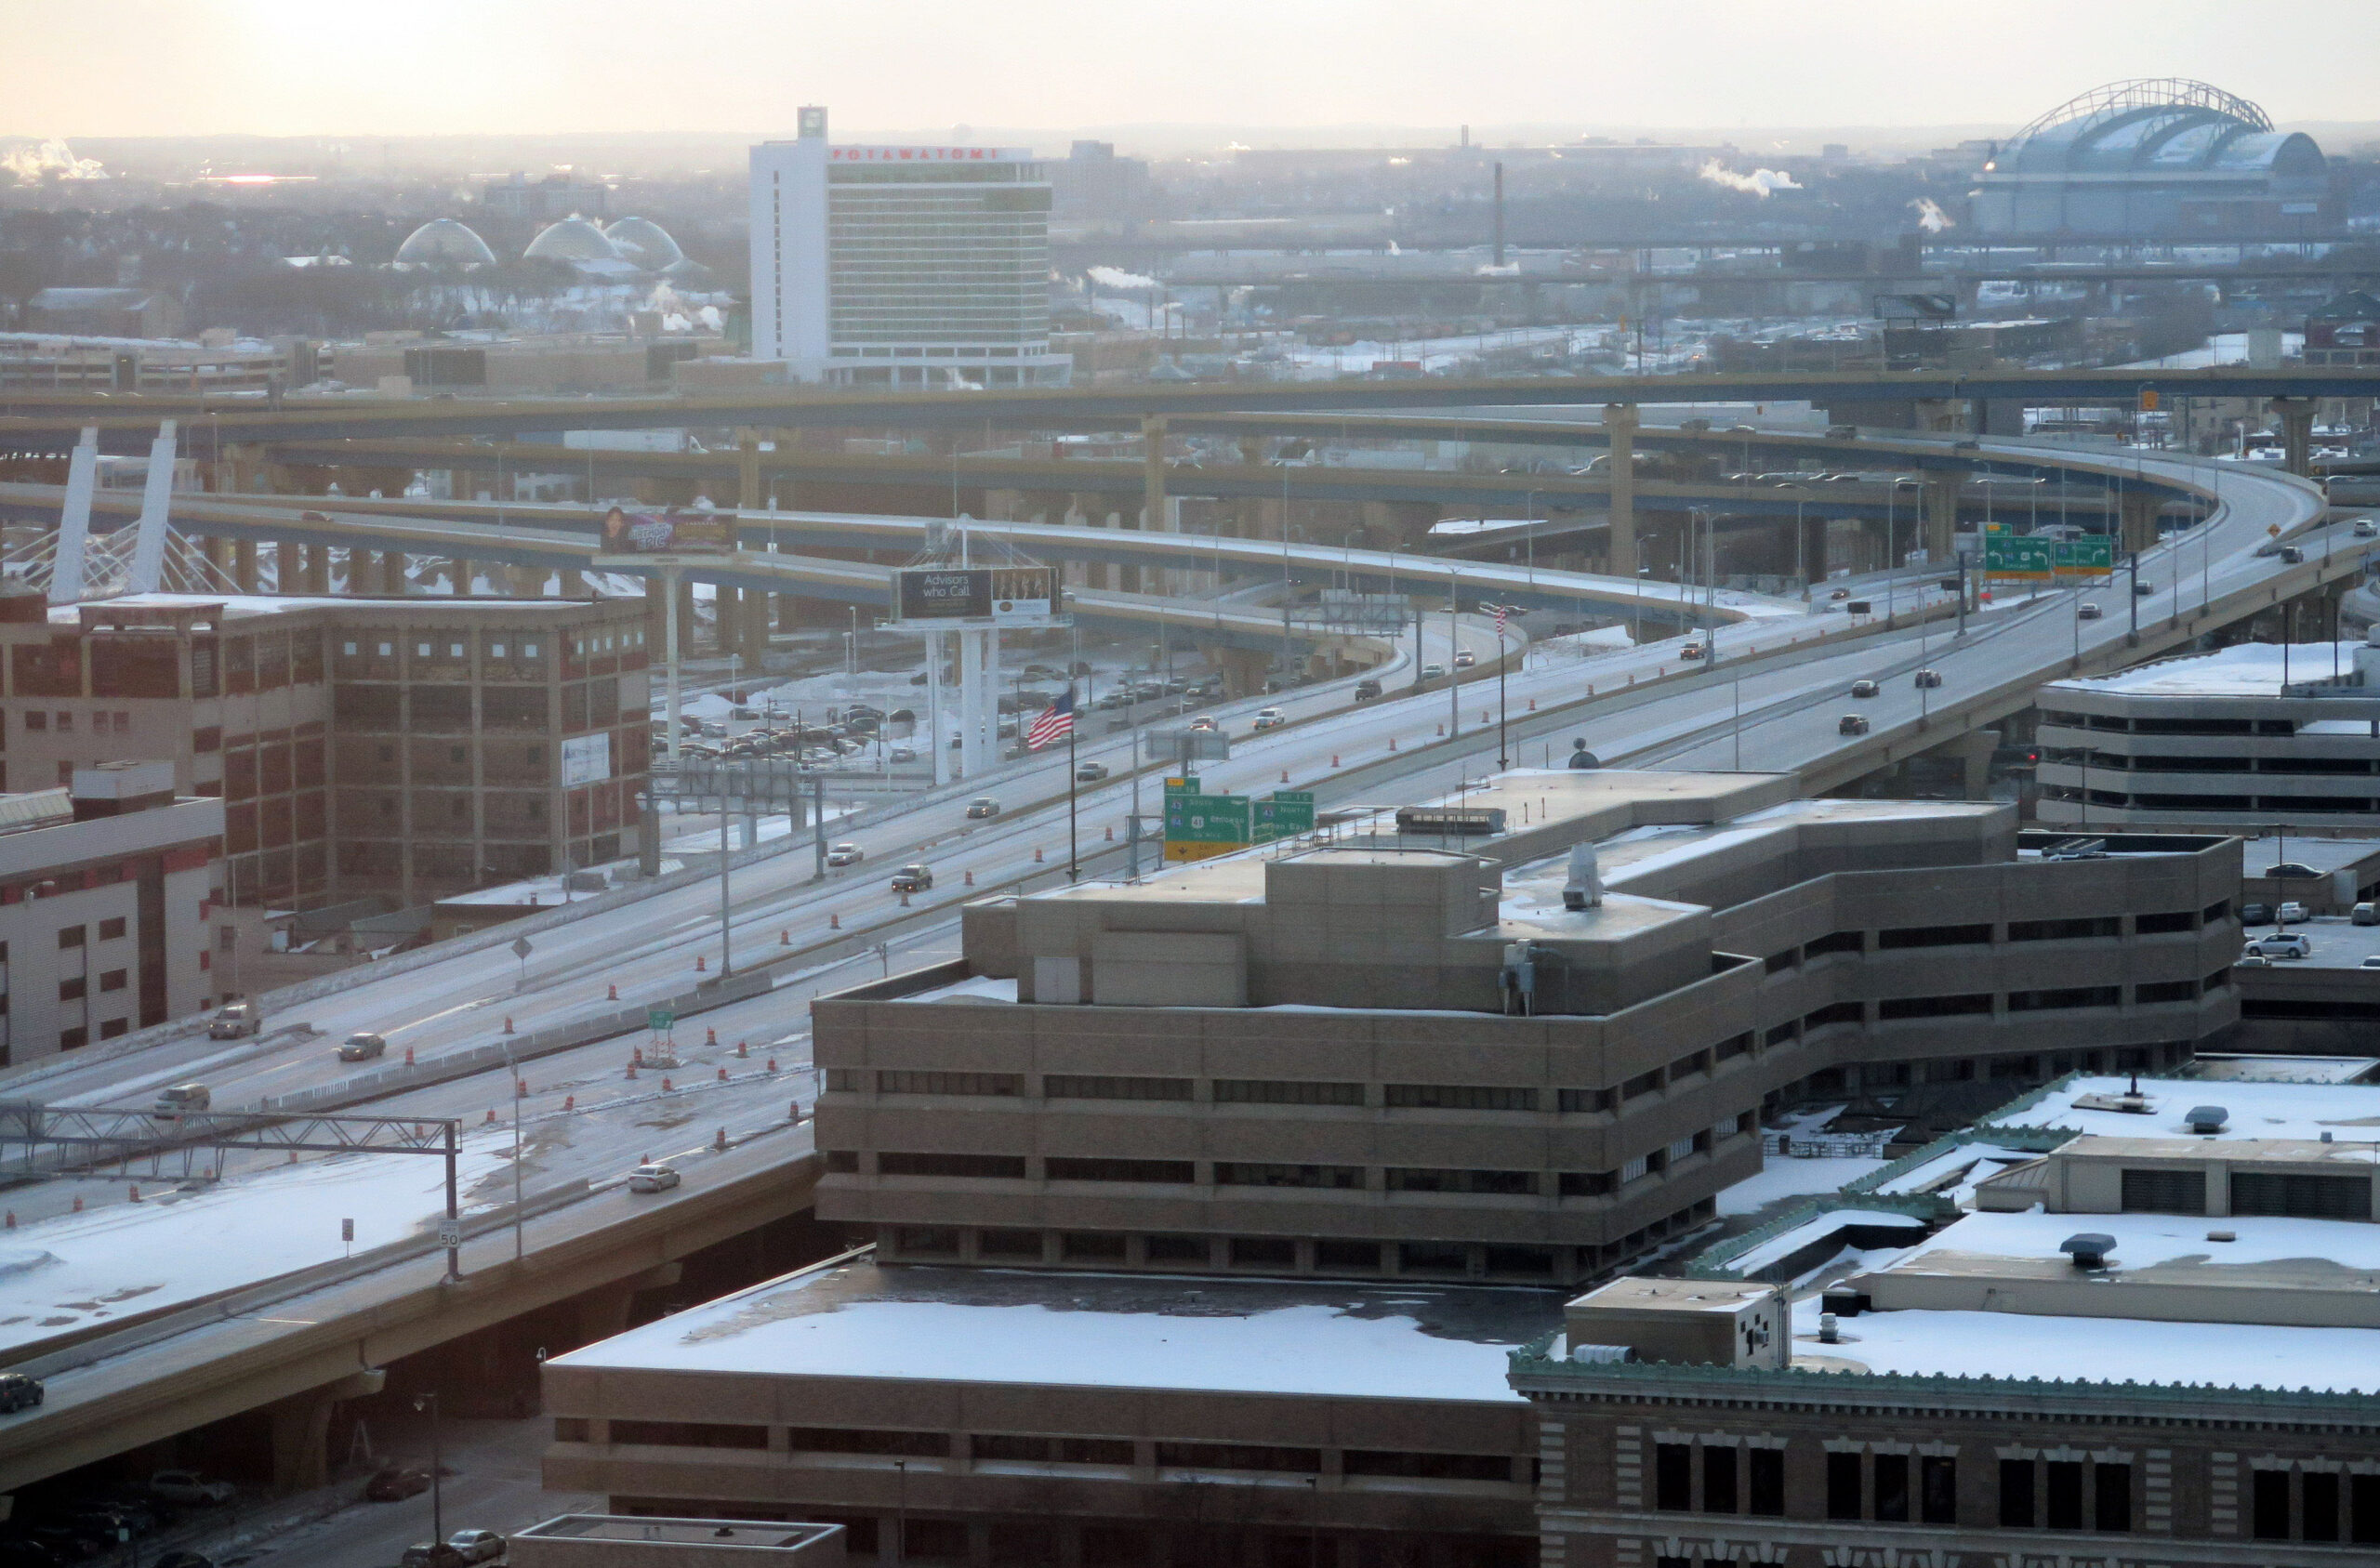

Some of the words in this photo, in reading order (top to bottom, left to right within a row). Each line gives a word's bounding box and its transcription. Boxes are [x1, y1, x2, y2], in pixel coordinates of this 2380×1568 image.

[833, 149, 997, 161] POTAWATOMI
[924, 575, 969, 585] Advisors
[923, 586, 946, 597] who
[950, 586, 971, 597] Call
[1193, 818, 1203, 826] 41
[441, 1234, 458, 1245] 50
